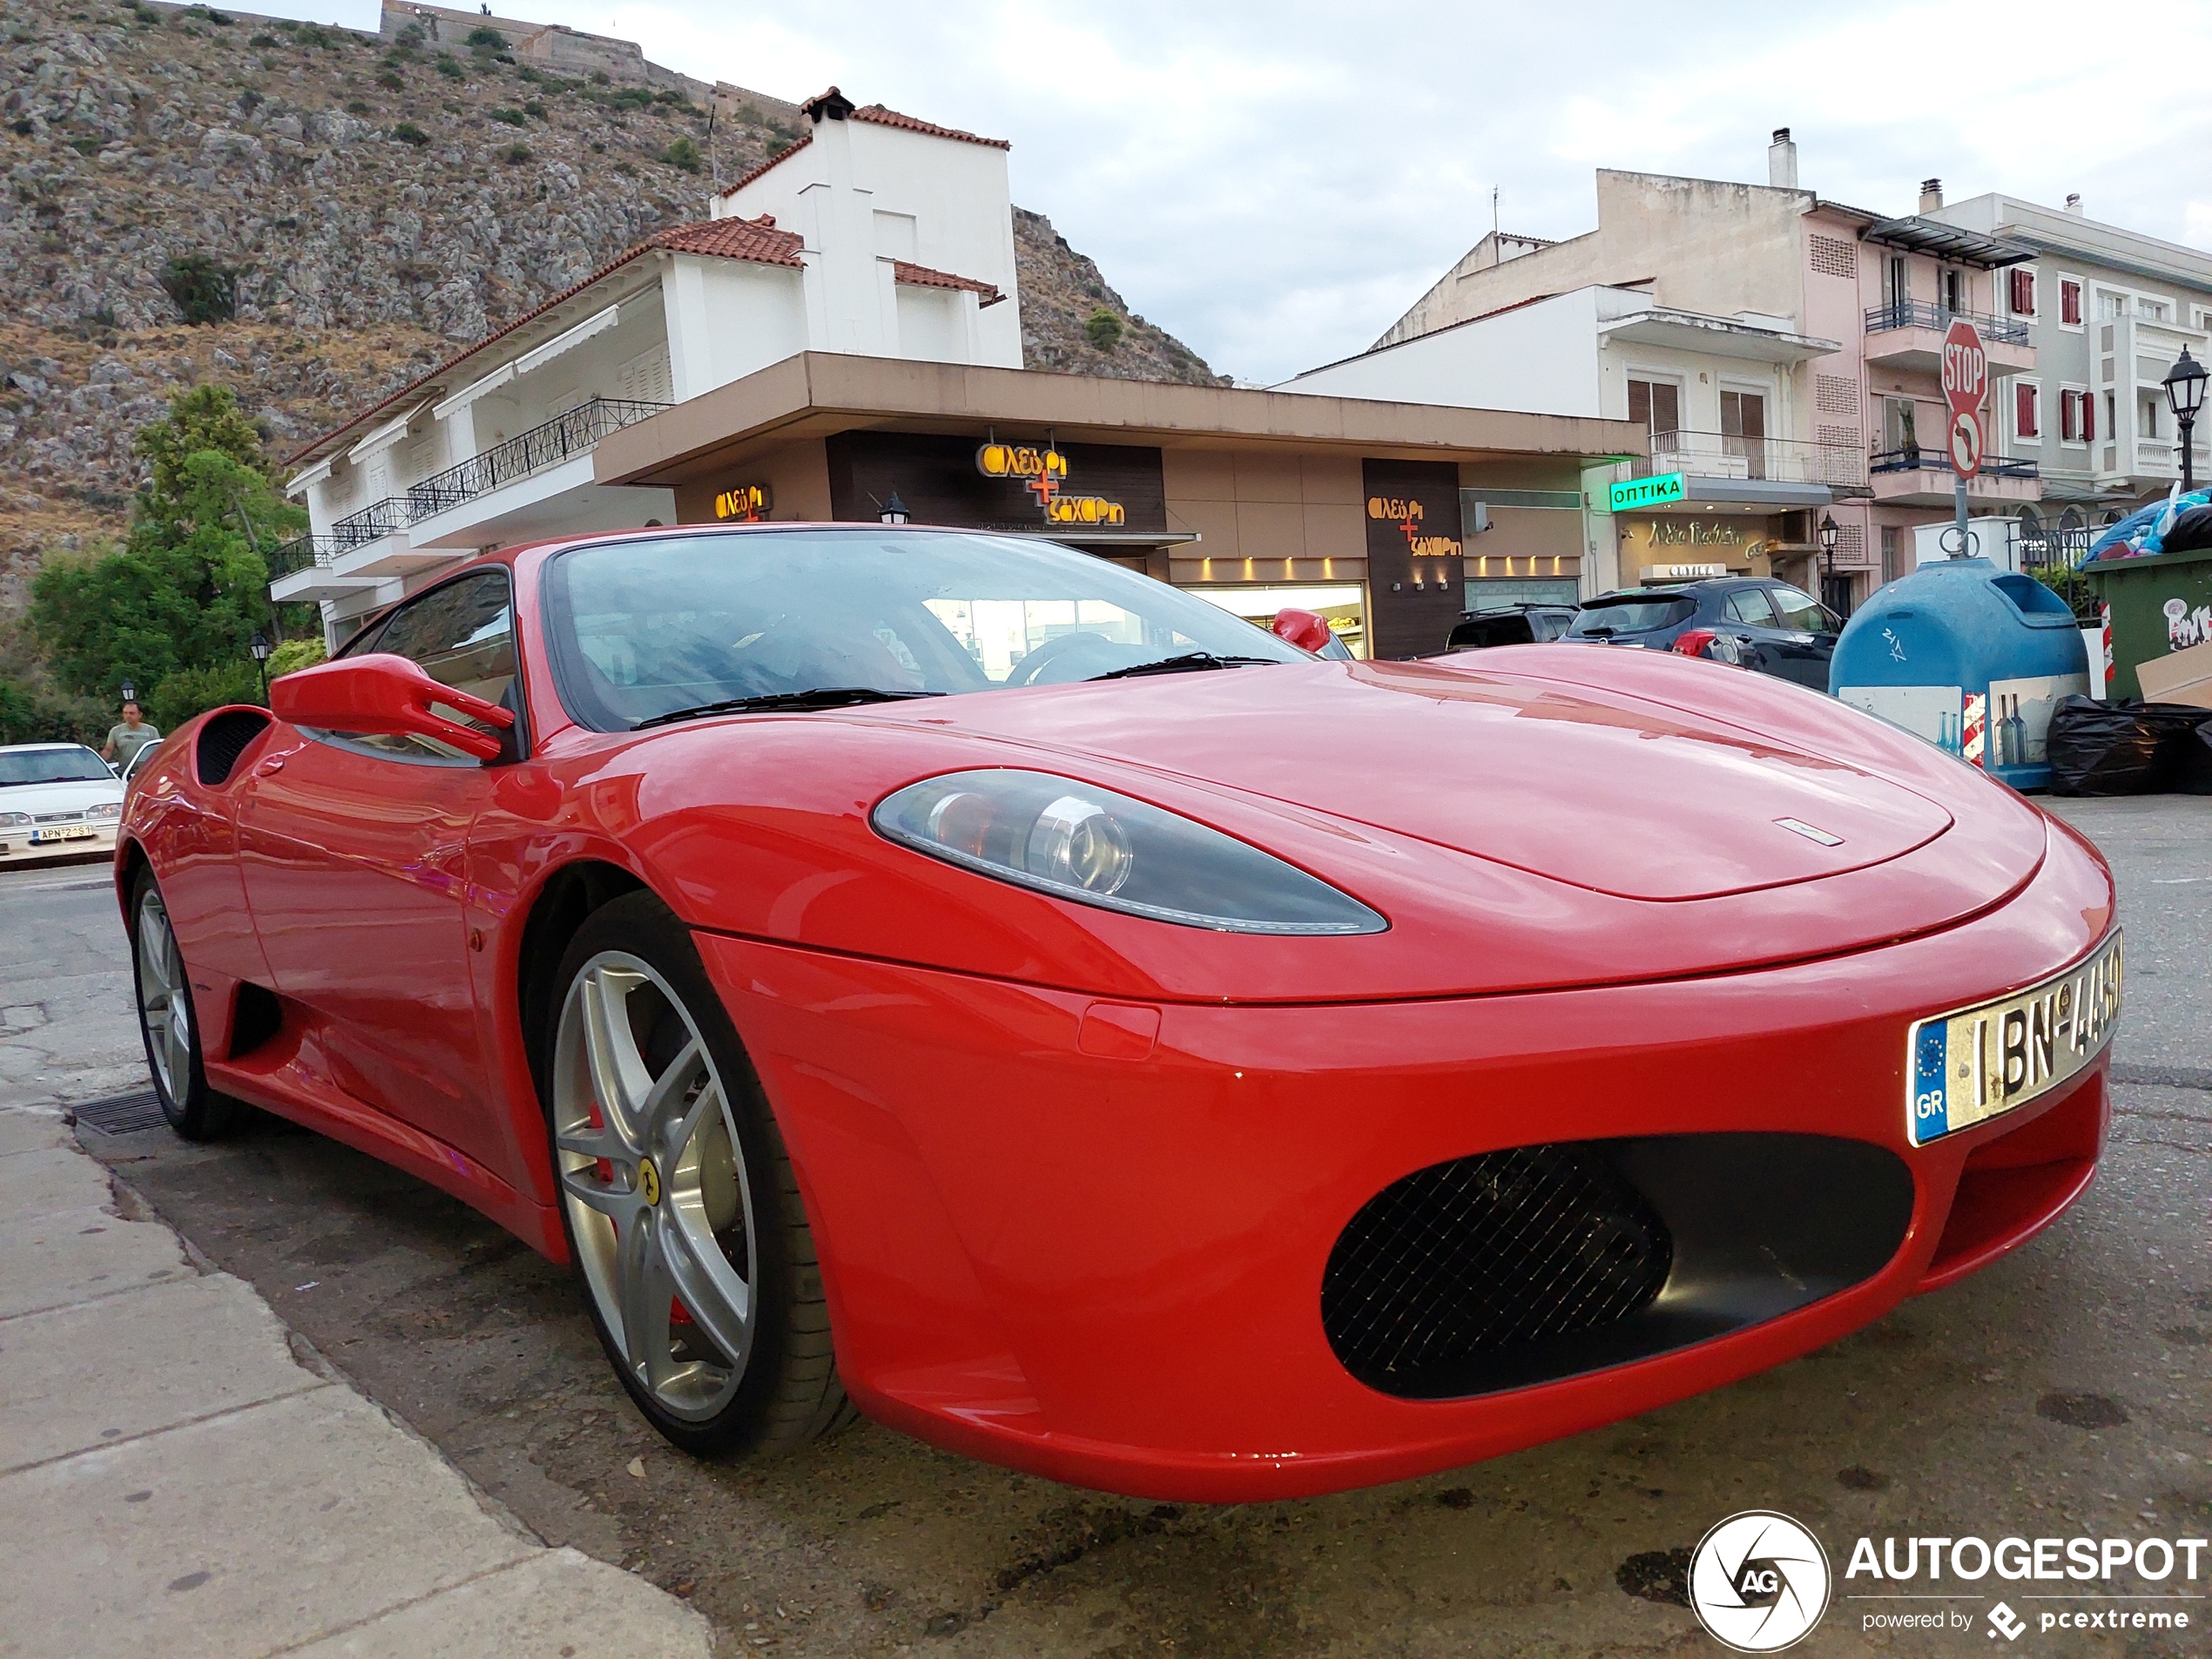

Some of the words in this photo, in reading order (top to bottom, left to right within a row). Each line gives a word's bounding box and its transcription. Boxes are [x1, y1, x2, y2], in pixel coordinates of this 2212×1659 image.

[1945, 342, 1984, 395] STOP
[1614, 480, 1681, 503] ΟΠΤΙΚΑ
[1917, 1089, 1944, 1119] GR
